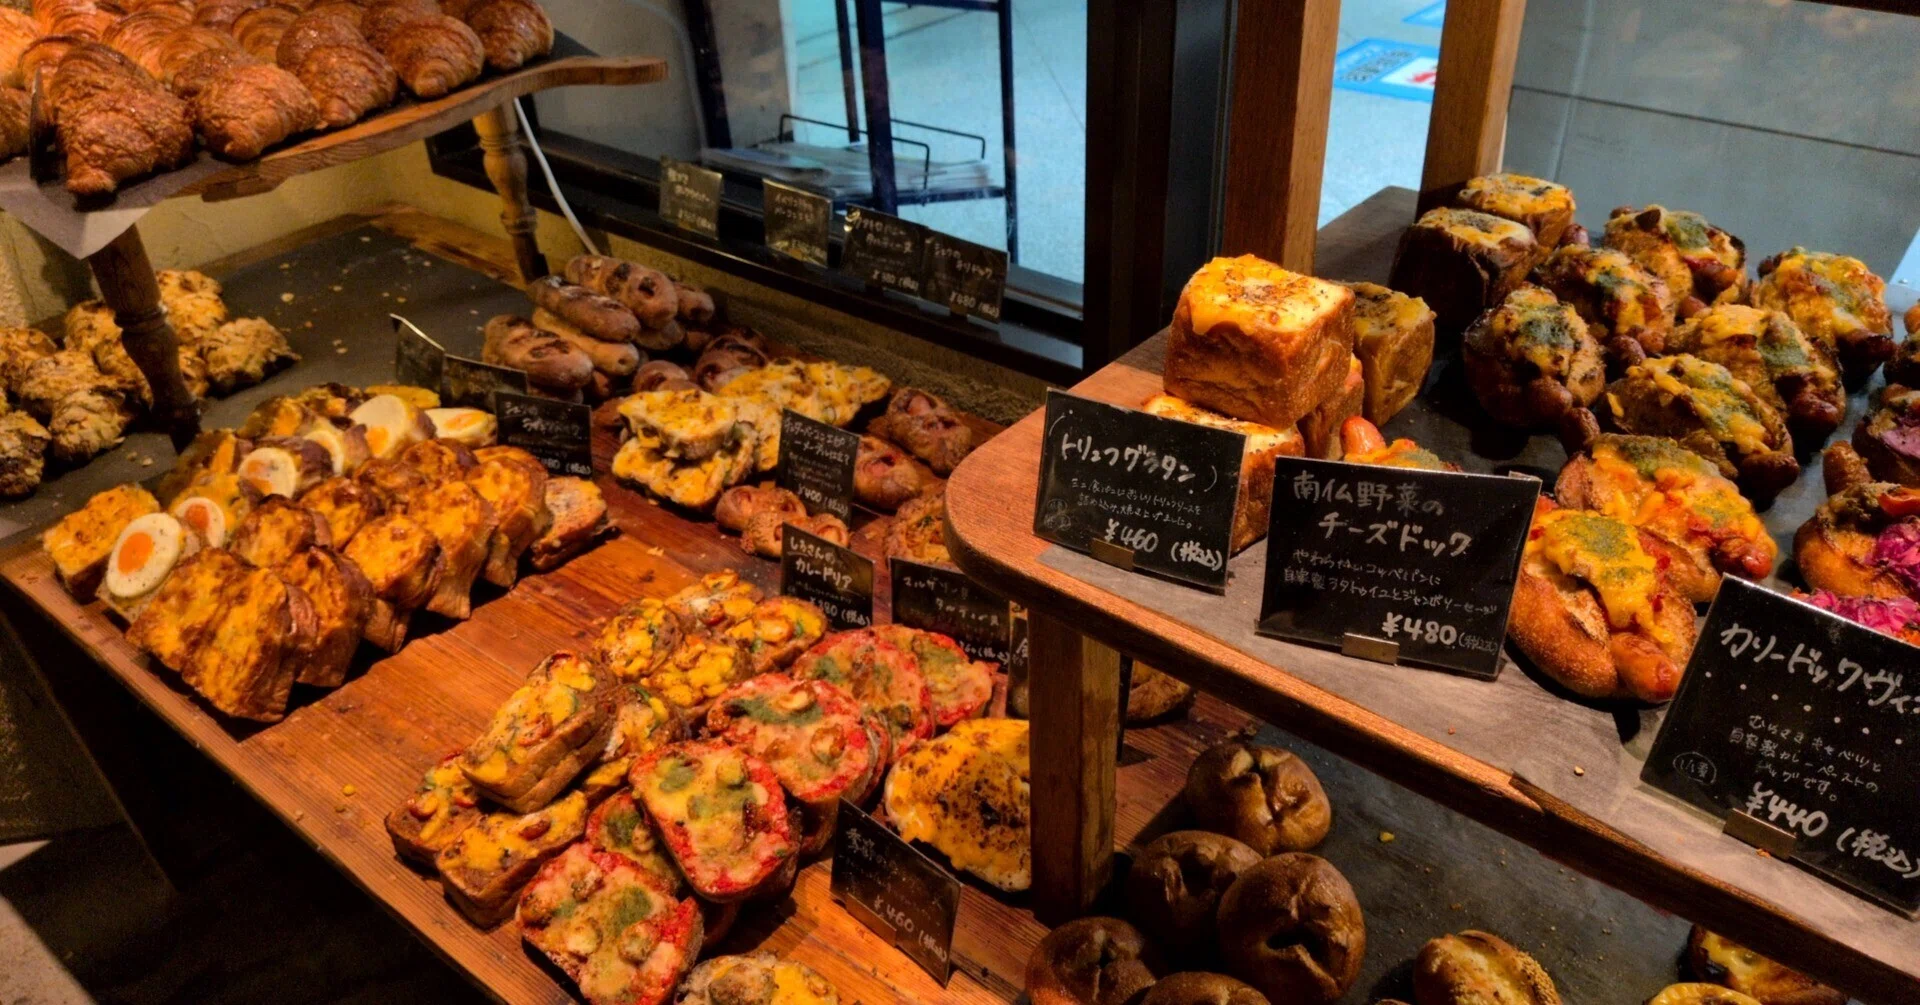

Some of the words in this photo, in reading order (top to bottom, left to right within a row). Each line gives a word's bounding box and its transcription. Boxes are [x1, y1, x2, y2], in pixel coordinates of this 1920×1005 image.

[1293, 470, 1445, 518] 南仏野菜の
[1104, 518, 1159, 552] ¥460
[1318, 511, 1473, 558] チーズドック
[1382, 612, 1457, 646] ¥480
[1745, 781, 1829, 838] ¥440
